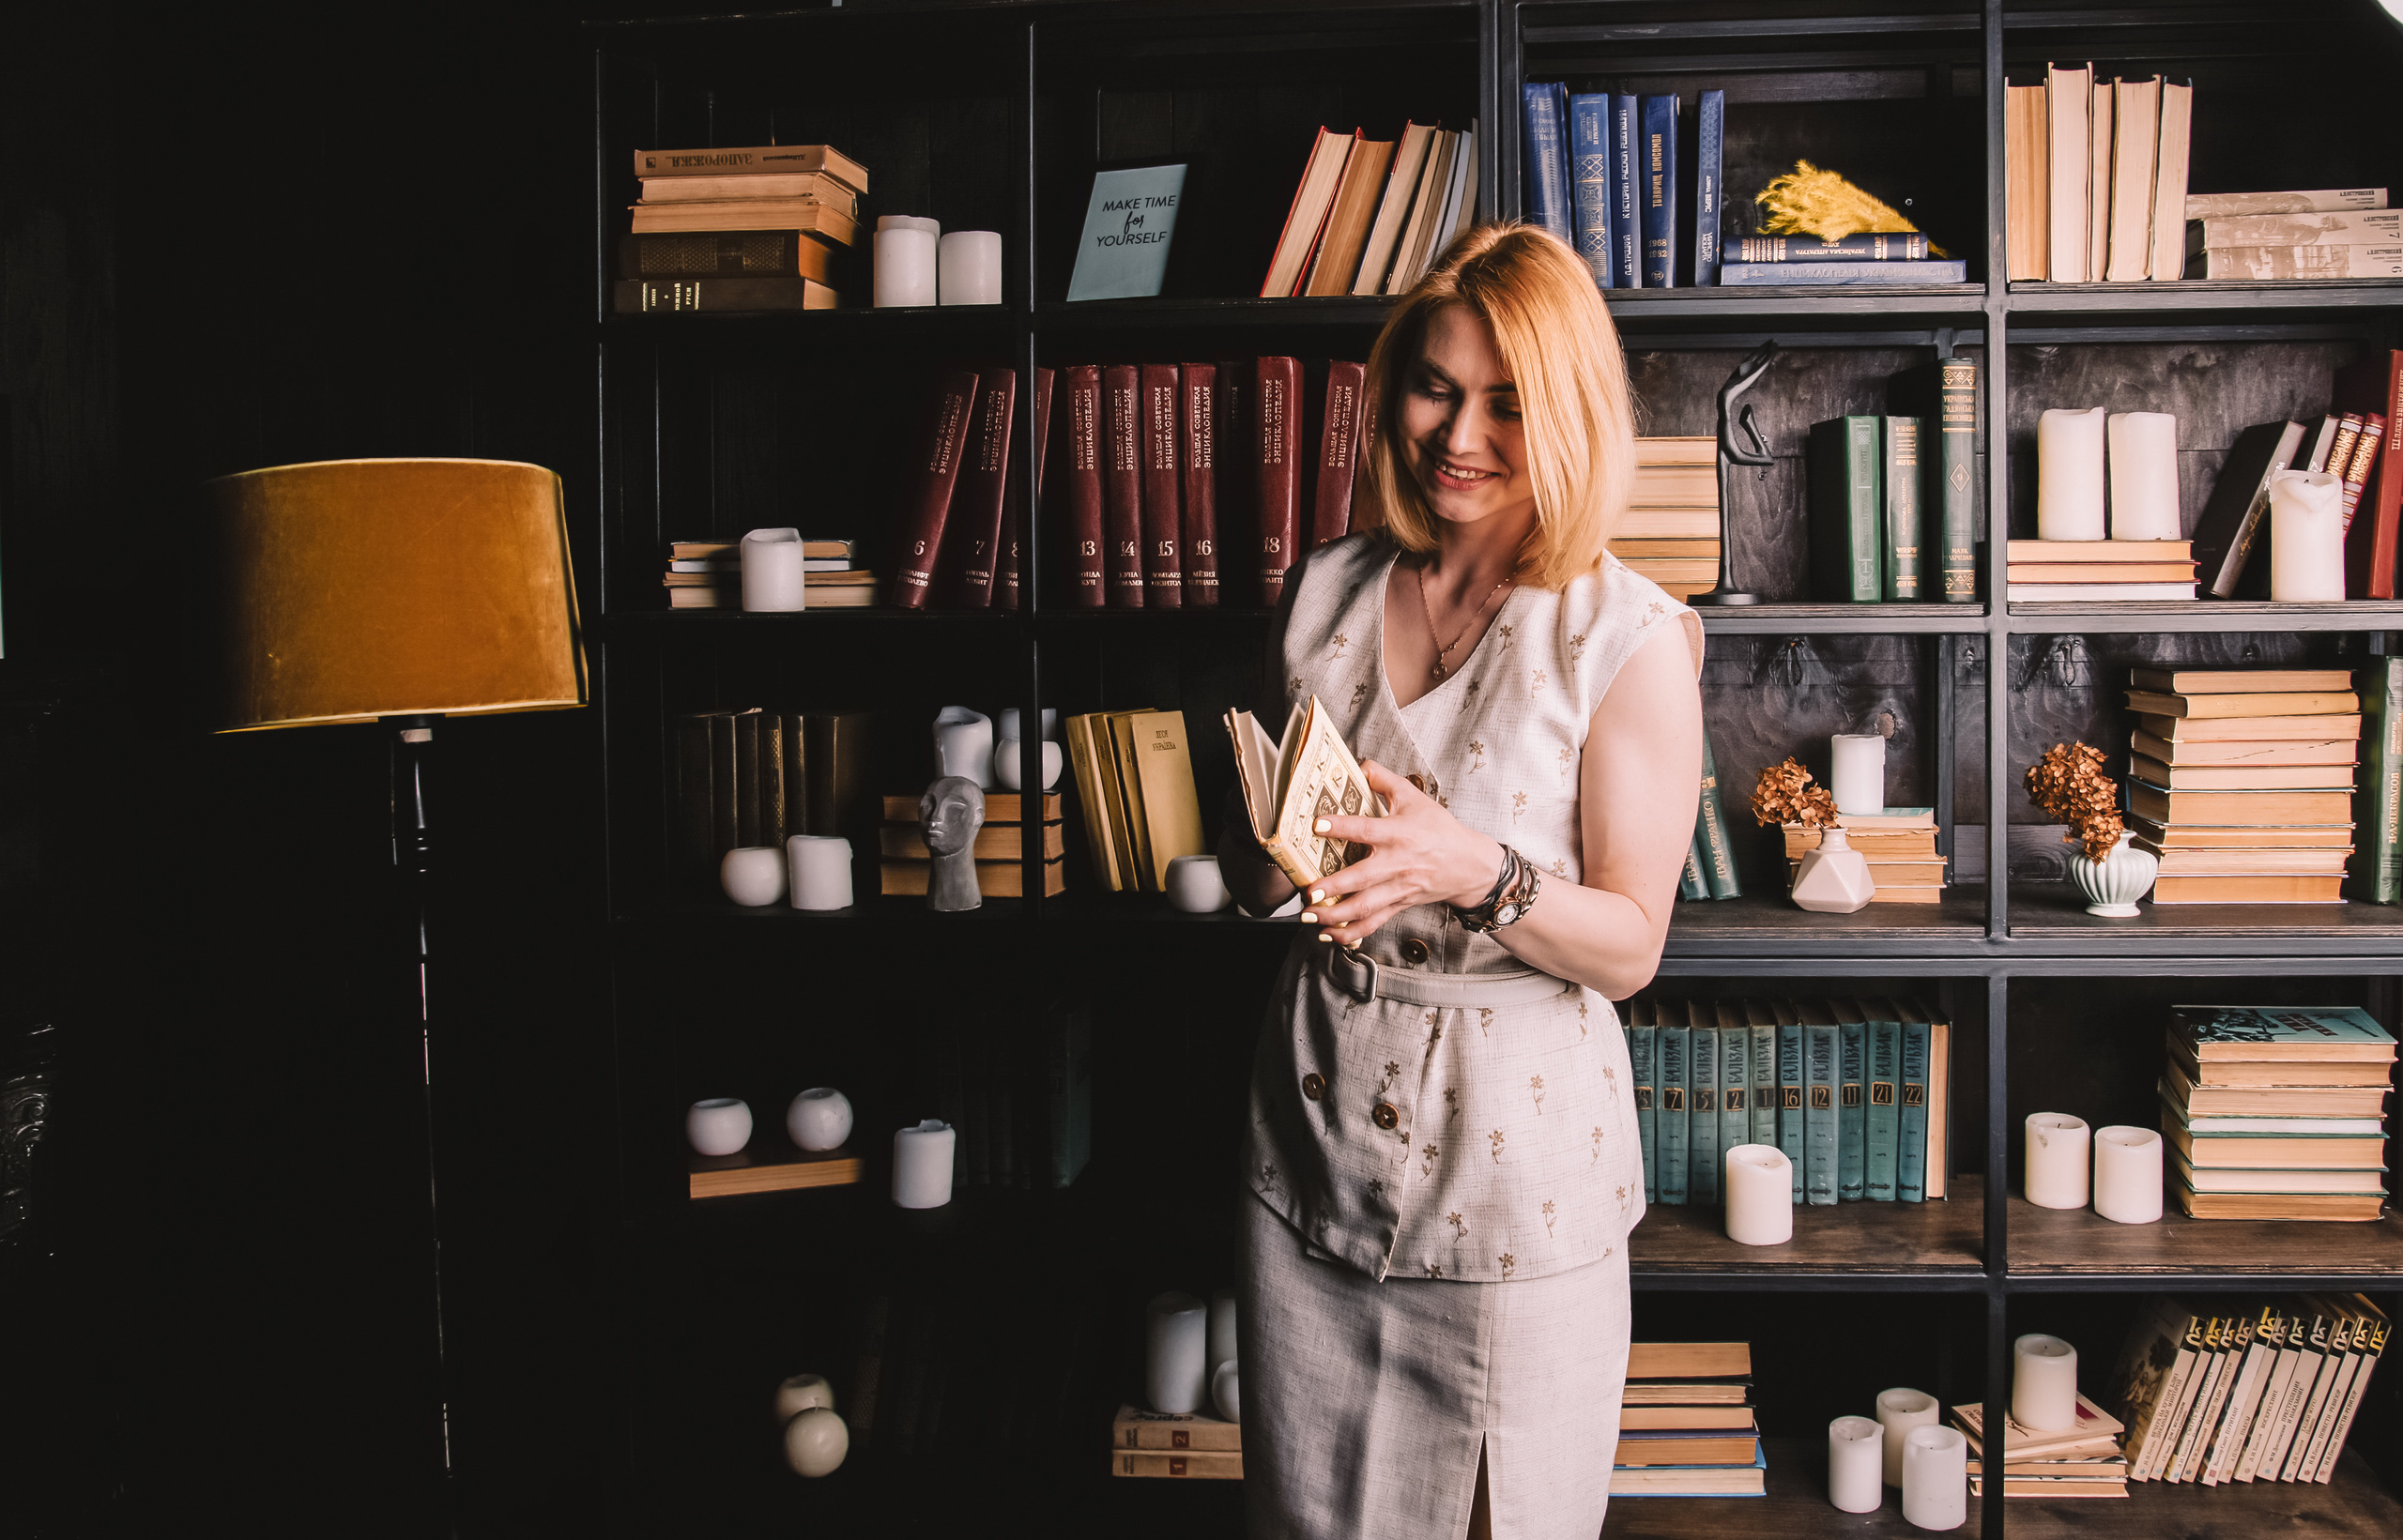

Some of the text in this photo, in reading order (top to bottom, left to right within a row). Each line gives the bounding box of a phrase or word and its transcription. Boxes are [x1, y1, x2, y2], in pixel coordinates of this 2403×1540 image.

[1652, 133, 1663, 208] ТОВАРИЩ КОМСОМОЛ
[1102, 195, 1177, 212] MAKE TIME
[1622, 182, 1630, 210] ИСТОРИИ
[1125, 210, 1144, 235] for
[1096, 231, 1168, 247] YOURSELF
[1648, 238, 1667, 248] 1968
[1648, 250, 1668, 258] 1982
[1084, 389, 1094, 470] ЭНЦИКЛОПЕДИЯ
[1125, 389, 1134, 470] ЭНЦИКЛОПЕДИЯ
[1164, 387, 1173, 469] ЭНЦИКЛОПЕДИЯ
[1274, 379, 1282, 464] ЭНЦИКЛОПЕДИЯ
[1329, 385, 1343, 467] БОЛЬШАЯ СОВЕТСКАЯ
[1338, 387, 1353, 468] ЭНЦИКЛОПЕДИЯ
[939, 395, 962, 475] ЭНЦИКЛОПЕДИЯ
[914, 541, 926, 556] 6
[976, 541, 986, 555] 7
[1080, 541, 1096, 557] 13
[1121, 541, 1135, 557] 14
[1158, 541, 1173, 557] 15
[1196, 540, 1212, 556] 16
[1263, 537, 1280, 554] 18
[901, 569, 930, 580] ЗЛИФТ
[1703, 801, 1727, 878] ІВАН ФРАНКО
[1635, 1036, 1651, 1082] БАЛЬЗАК
[1664, 1036, 1681, 1083] БАЛЬЗАК
[1697, 1038, 1713, 1084] БАЛЬЗАК
[1728, 1038, 1744, 1084] БАЛЬЗАК
[1757, 1036, 1772, 1082] БАЛЬЗАК
[1783, 1036, 1798, 1081] БАЛЬЗАК
[1814, 1034, 1829, 1081] БАЛЬЗАК
[1844, 1034, 1860, 1079] БАЛЬЗАК
[1875, 1031, 1892, 1076] БАЛЬЗАК
[1906, 1032, 1923, 1078] БАЛЬЗАК
[1638, 1090, 1648, 1107] 8
[1670, 1091, 1678, 1108] 7
[1701, 1092, 1710, 1109] 5
[1731, 1092, 1740, 1108] 2
[1763, 1090, 1768, 1106] 1
[1784, 1089, 1798, 1106] 16
[1814, 1089, 1828, 1106] 12
[1846, 1087, 1857, 1104] 11
[1876, 1085, 1889, 1103] 21
[1906, 1087, 1921, 1104] 22
[2219, 1362, 2233, 1388] ПОВЕСТИ
[2150, 1418, 2163, 1438] ВЕЧЕРА
[2162, 1389, 2173, 1409] ХУТОРЕ
[2195, 1395, 2205, 1413] ИВАНА
[2259, 1389, 2279, 1429] ВОСКРЕСЕНИЕ
[2279, 1380, 2301, 1422] ПРЕСТУПЛЕНИЕ
[2288, 1387, 2305, 1419] НАКАЗАНИЕ
[2224, 1405, 2240, 1435] ПУРИТАНЕ
[2239, 1415, 2251, 1436] ПЬЕСЫ
[1175, 1436, 1186, 1444] 2
